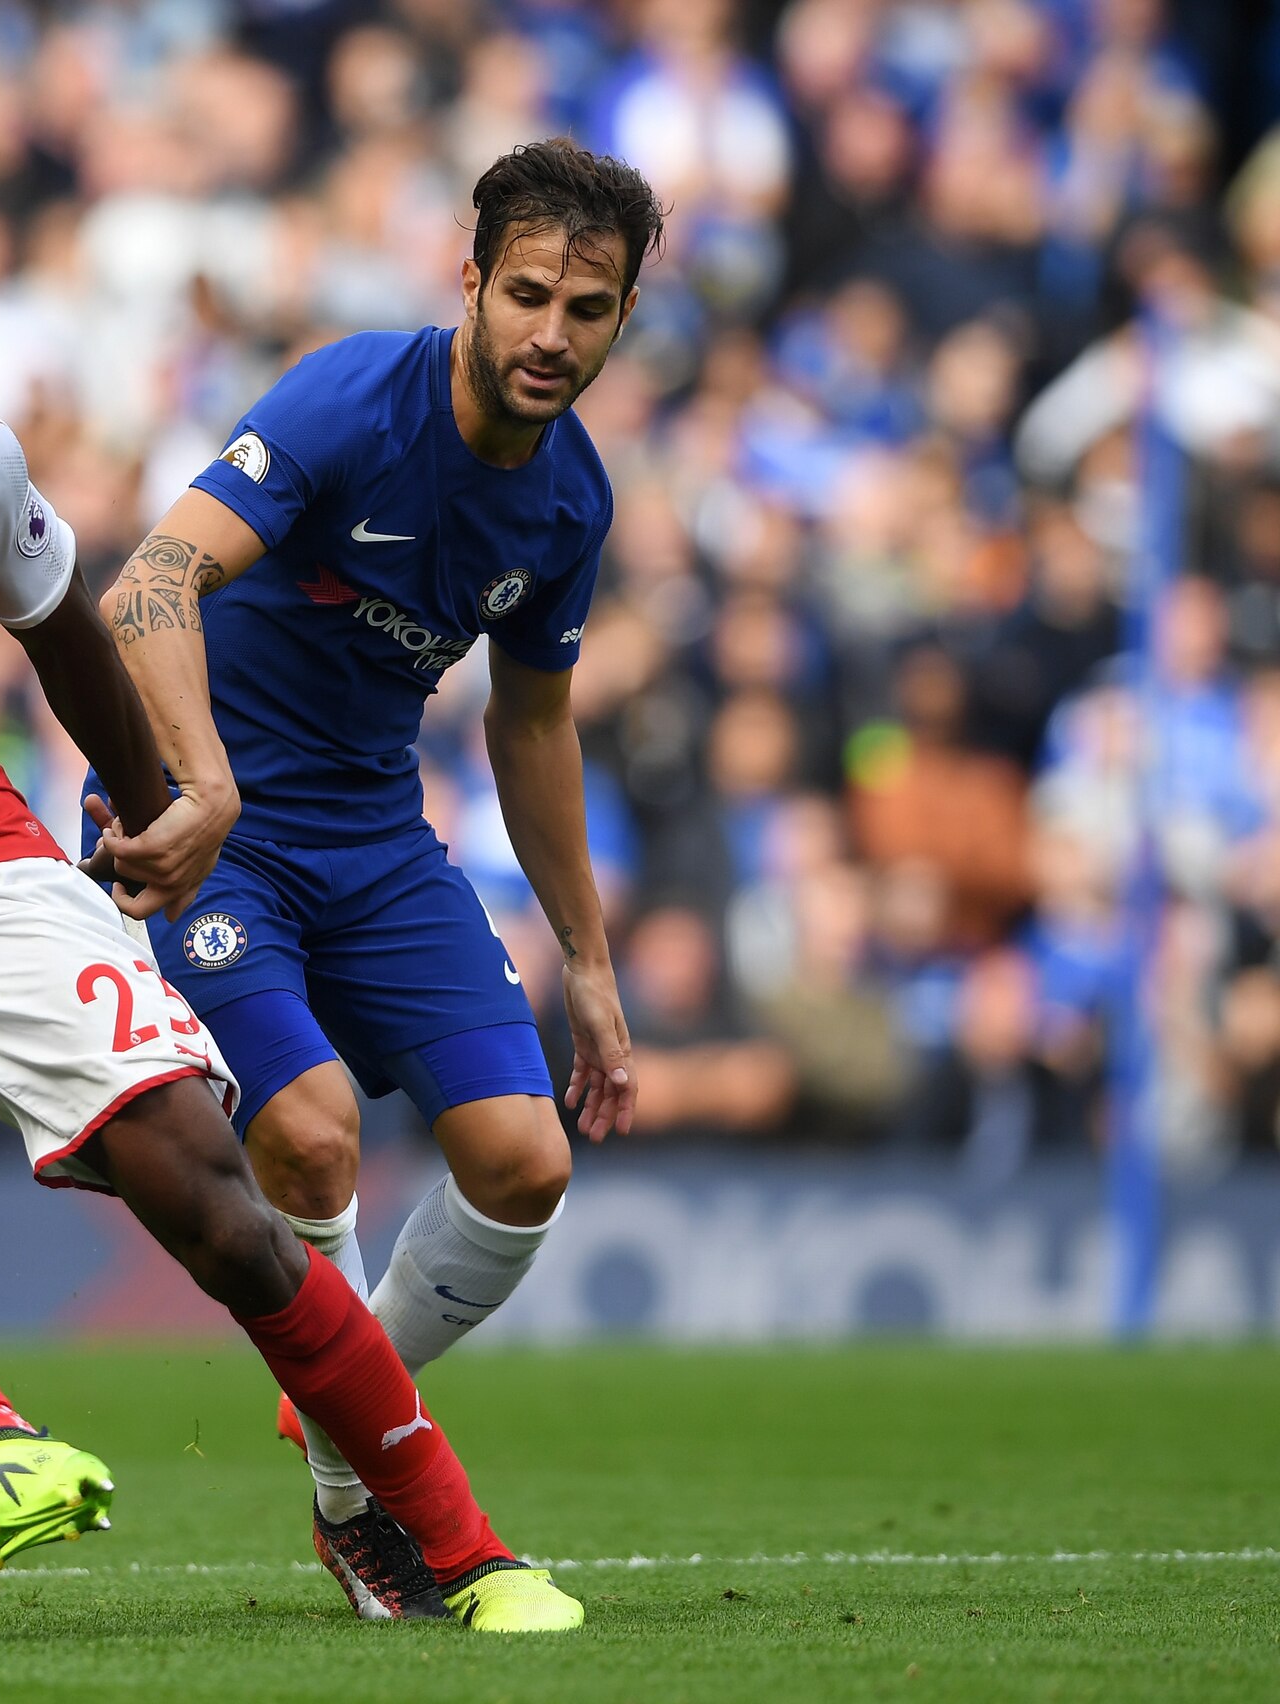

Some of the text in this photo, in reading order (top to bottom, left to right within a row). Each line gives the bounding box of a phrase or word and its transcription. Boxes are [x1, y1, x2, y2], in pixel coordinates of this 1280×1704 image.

[352, 597, 474, 657] YOKOHA
[189, 914, 230, 934] CHELSEA
[198, 949, 240, 967] FOOTBALL CLUB
[75, 959, 201, 1053] 23
[470, 1178, 1280, 1338] OKOHA
